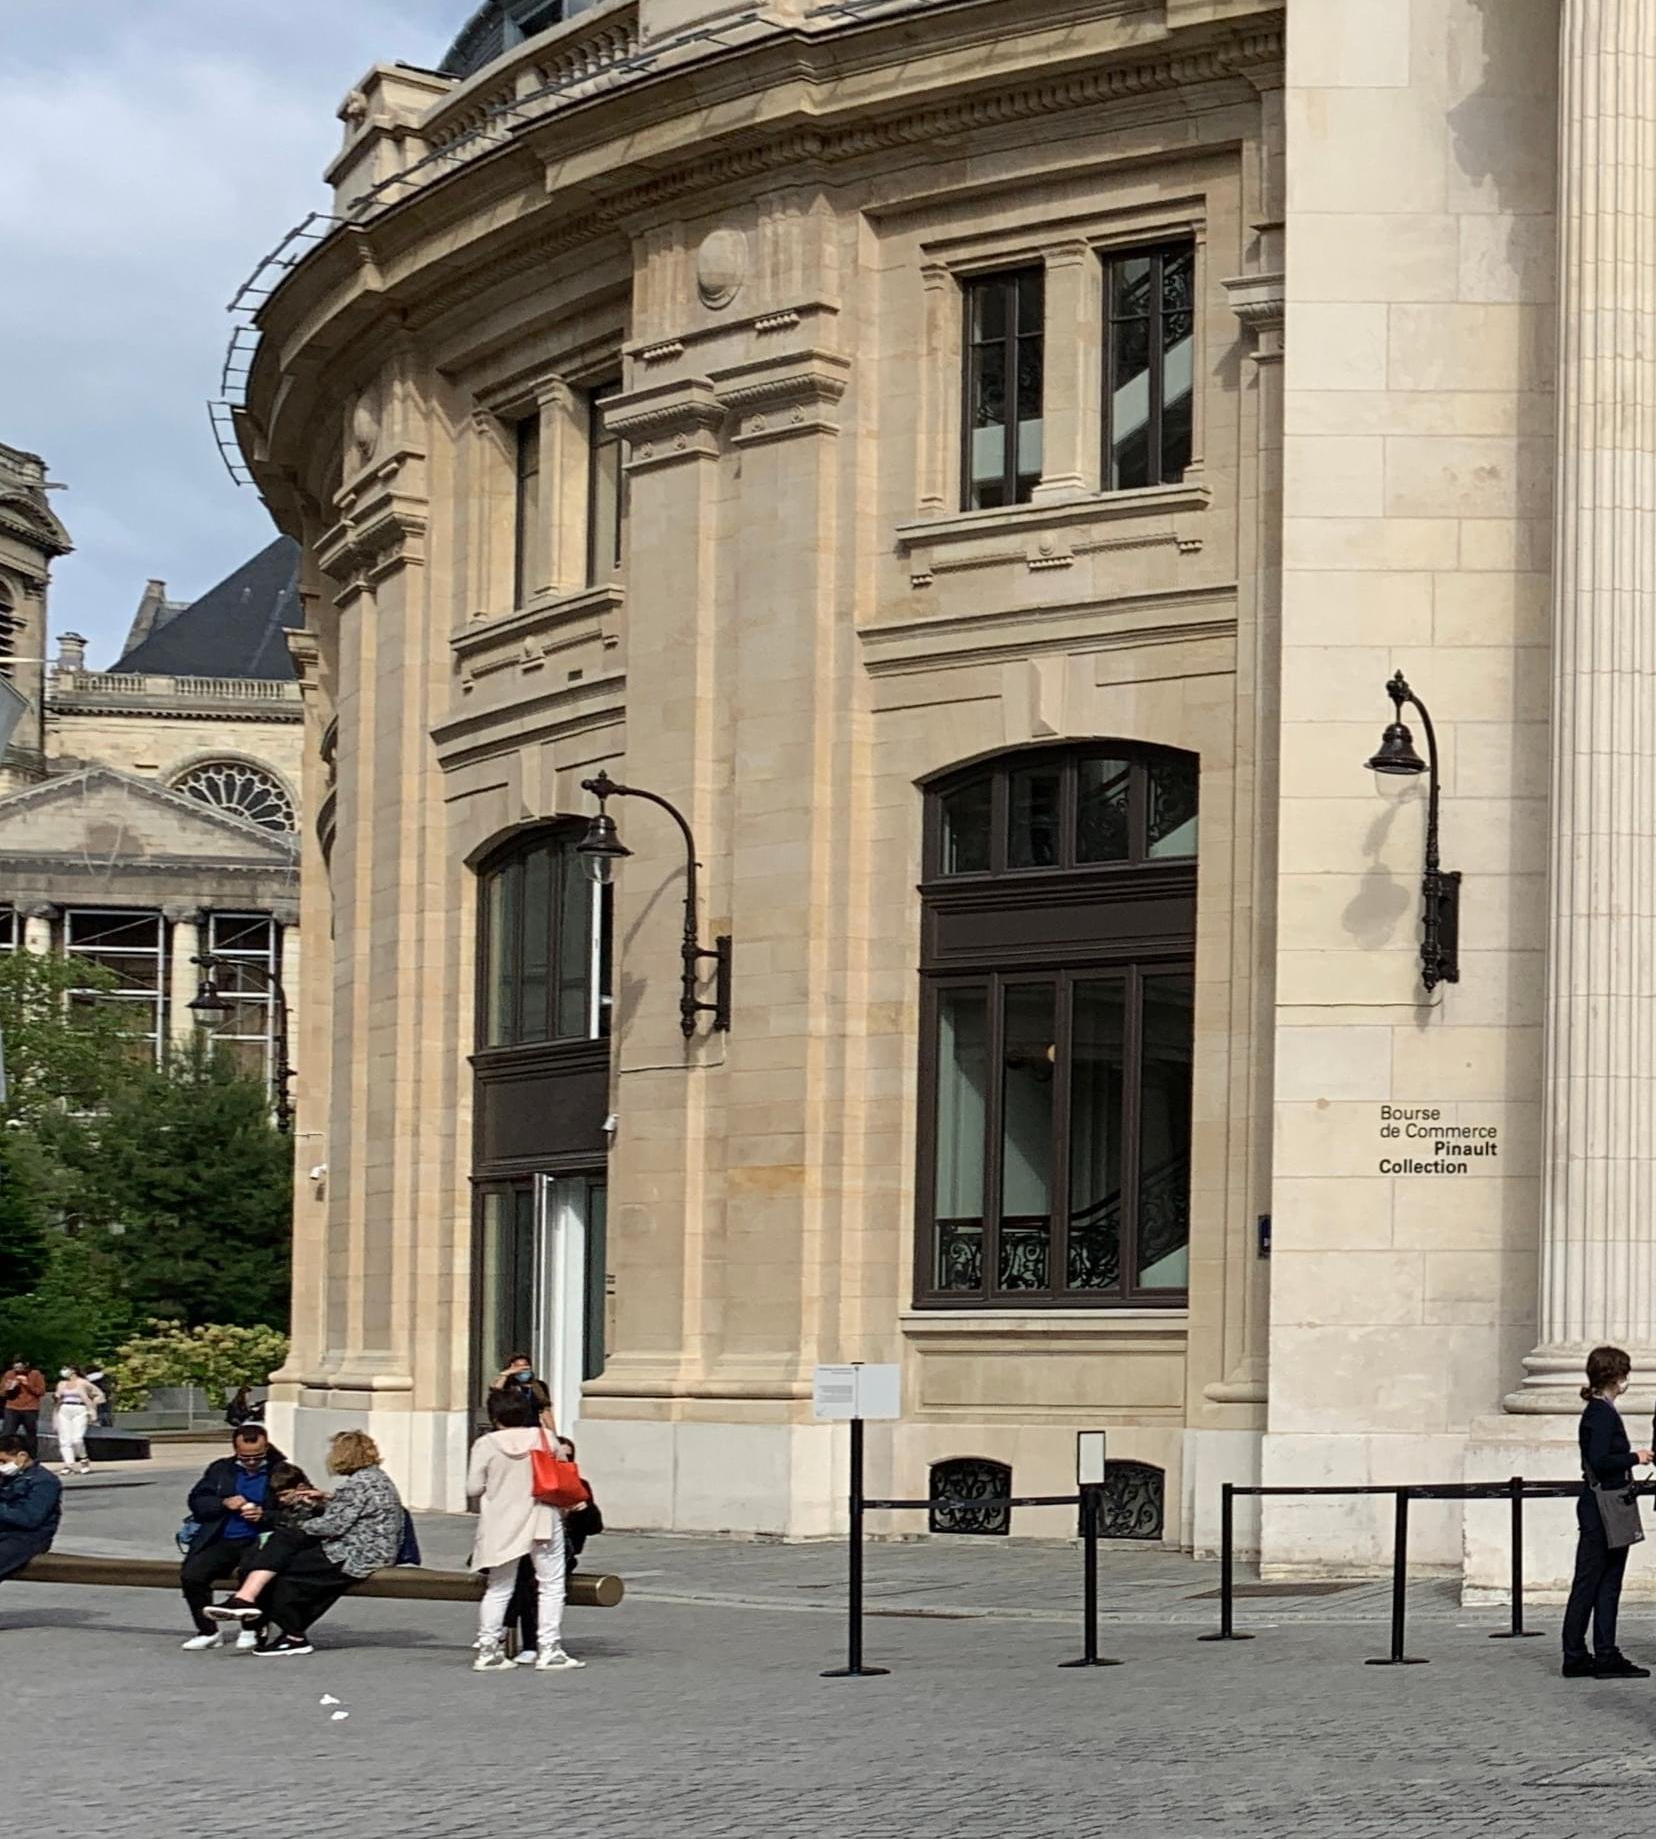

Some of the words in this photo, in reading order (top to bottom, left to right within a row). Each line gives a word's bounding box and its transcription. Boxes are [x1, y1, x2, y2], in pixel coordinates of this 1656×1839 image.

[1380, 1105, 1441, 1121] Bourse
[1380, 1124, 1401, 1139] de
[1405, 1123, 1498, 1139] Commerce
[1434, 1141, 1498, 1156] Pinault
[1379, 1159, 1468, 1174] Collection
